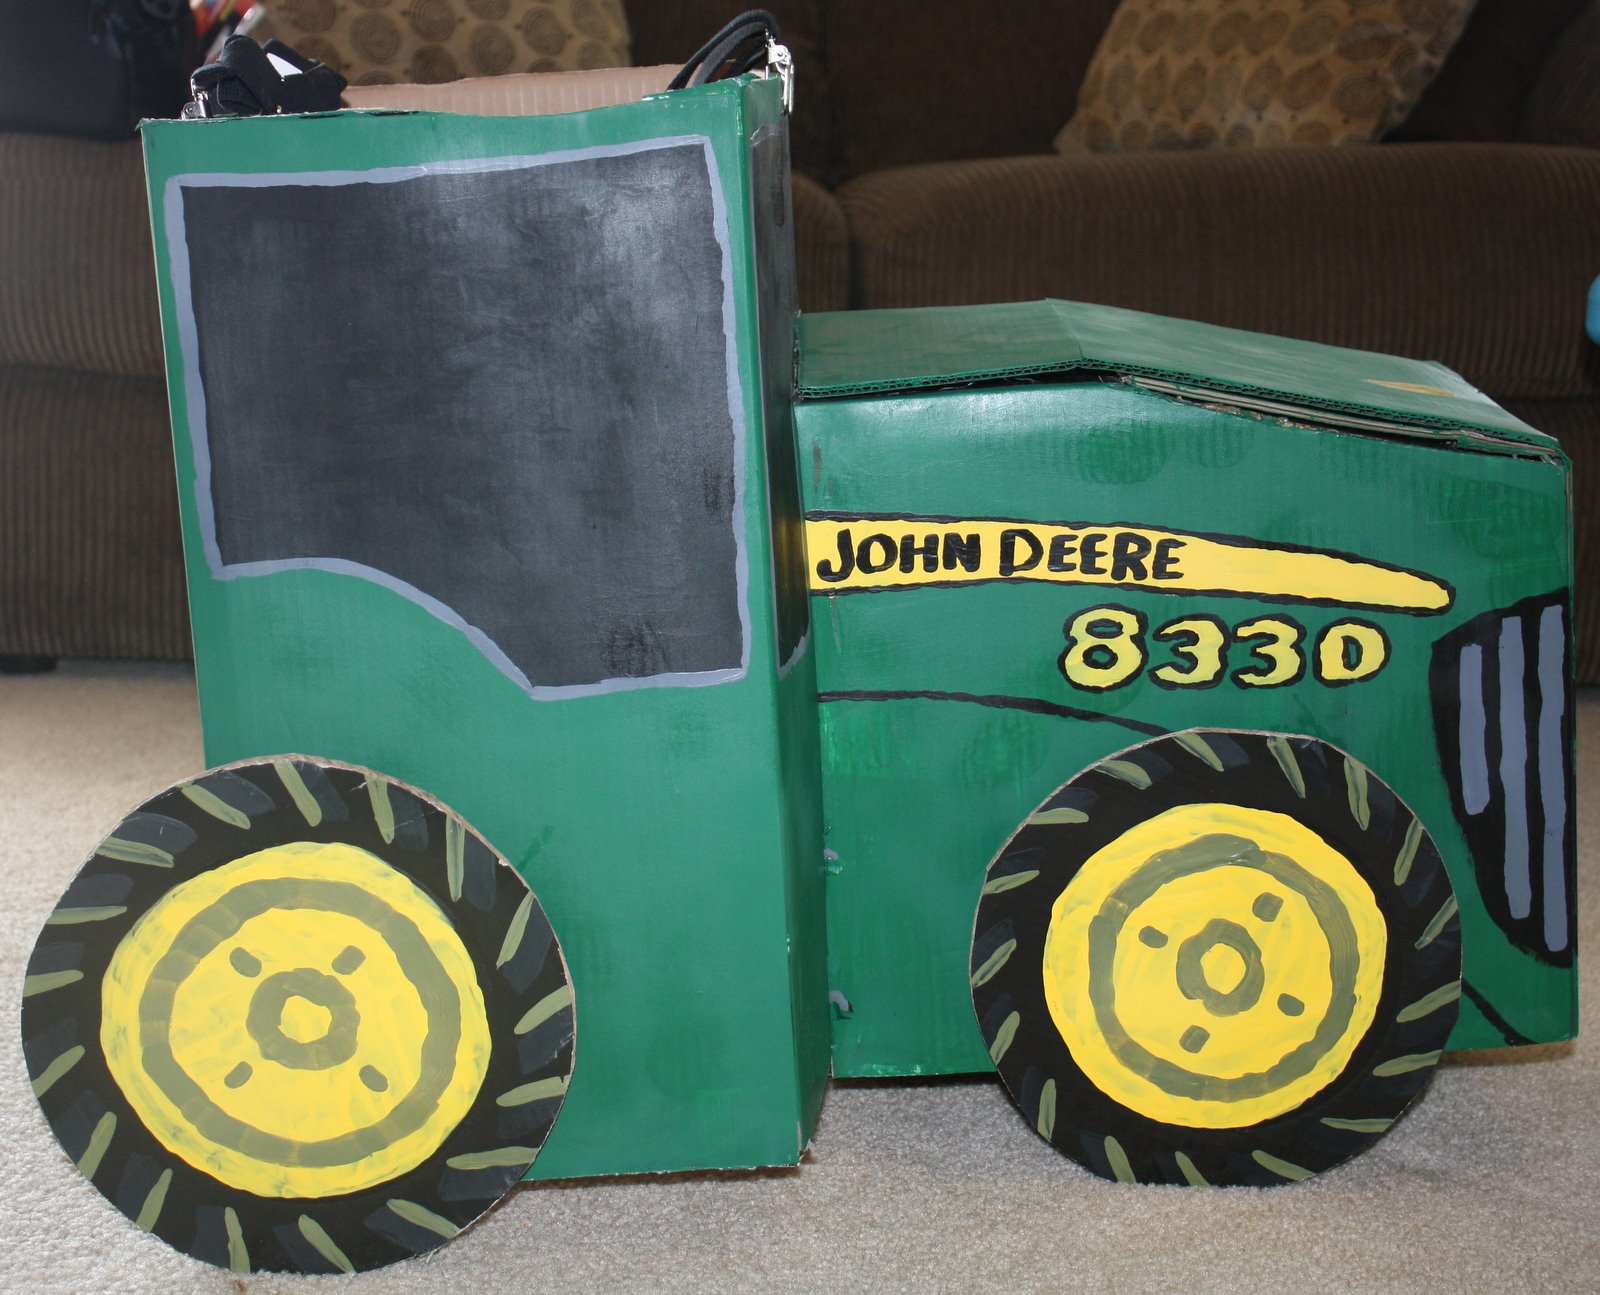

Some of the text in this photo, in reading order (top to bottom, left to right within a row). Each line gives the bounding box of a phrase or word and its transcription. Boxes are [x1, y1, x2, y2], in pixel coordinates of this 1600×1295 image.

[816, 528, 1188, 581] JOHN DEERE
[1057, 603, 1392, 694] 8330
